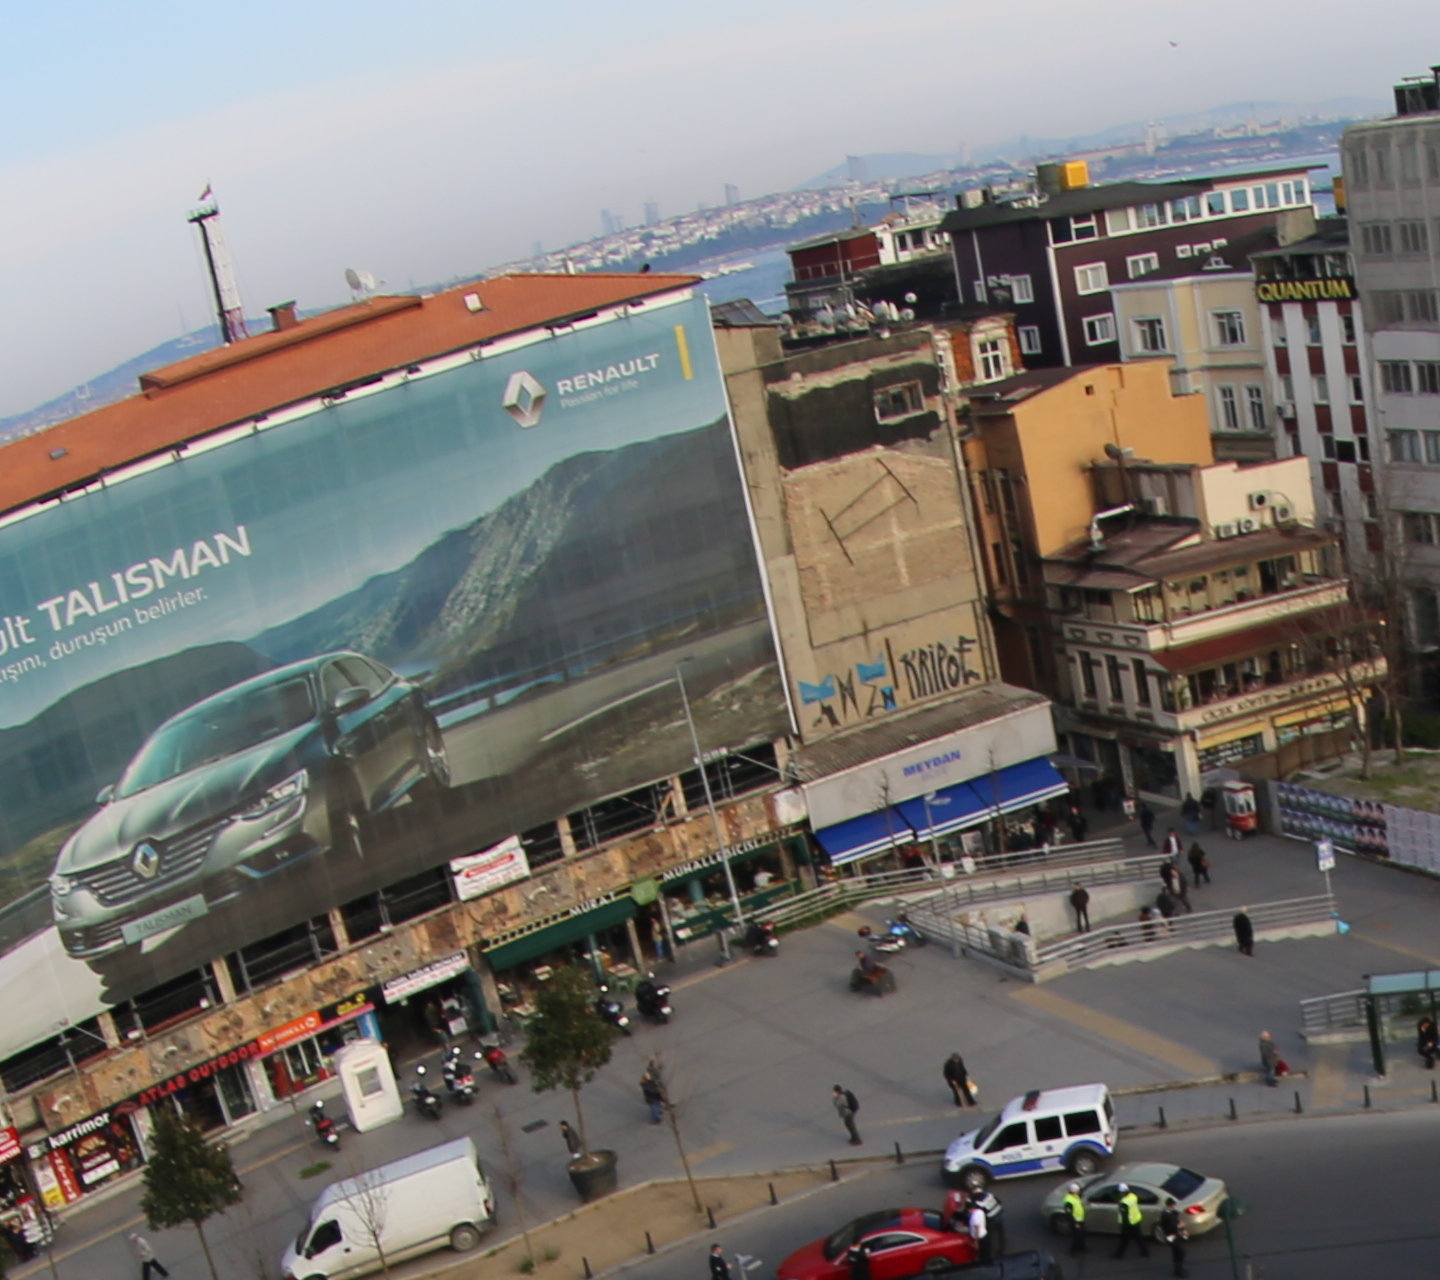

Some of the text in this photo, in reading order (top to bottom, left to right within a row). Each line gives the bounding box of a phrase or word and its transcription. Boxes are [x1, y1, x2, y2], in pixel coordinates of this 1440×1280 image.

[1258, 280, 1351, 301] QUANTUM
[556, 353, 660, 394] RENAULT
[37, 525, 253, 633] TALISMAN
[49, 617, 133, 661] duruşun
[134, 585, 208, 625] belirler.
[903, 750, 961, 777] MEYDAN
[569, 892, 616, 918] MURAT
[139, 1041, 260, 1105] ATLAS OUTDOOR
[48, 1111, 110, 1149] karrimor
